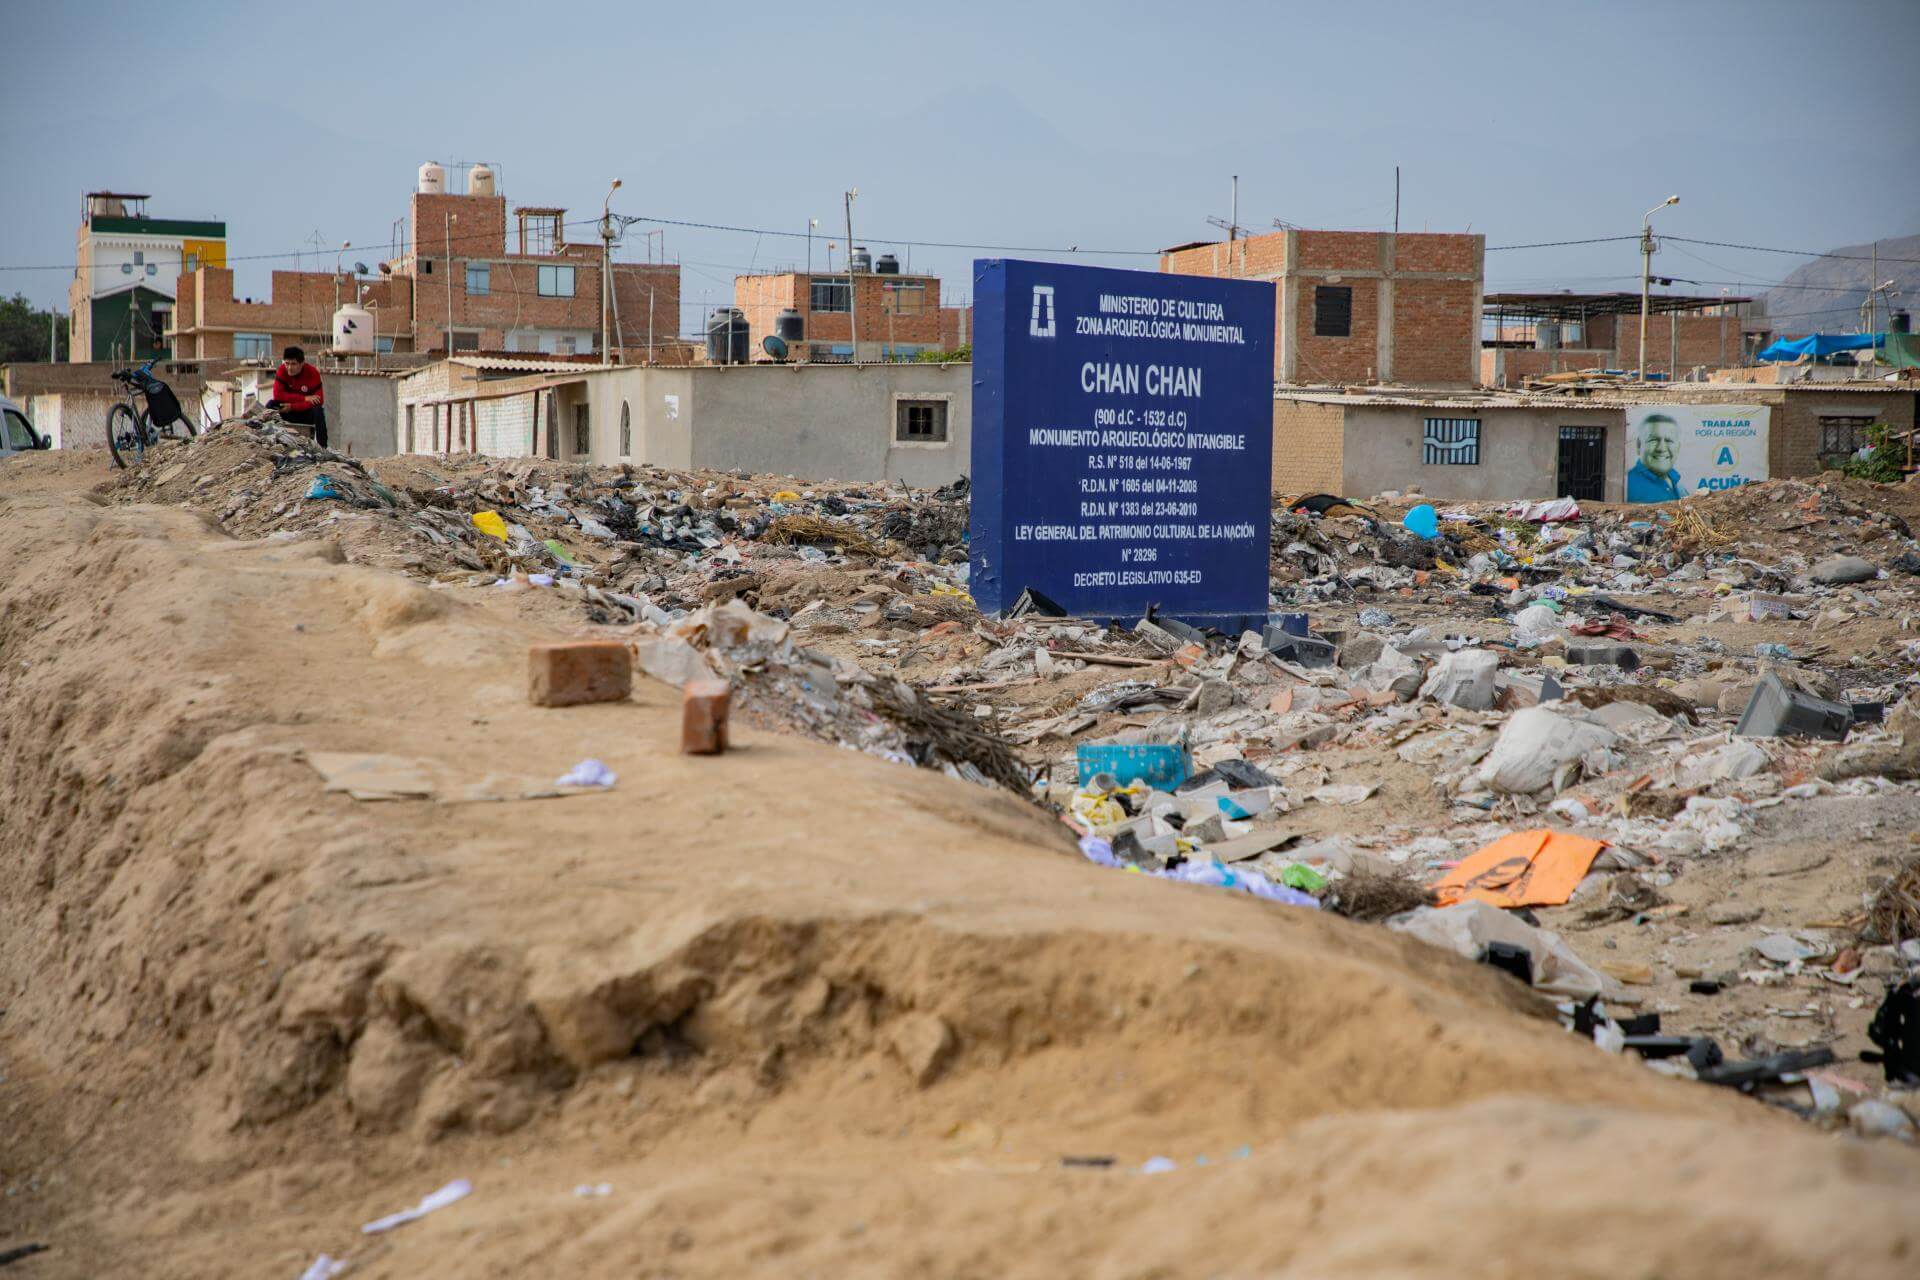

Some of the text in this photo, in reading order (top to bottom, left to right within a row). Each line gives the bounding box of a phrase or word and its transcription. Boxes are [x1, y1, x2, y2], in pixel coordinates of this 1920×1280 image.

[1099, 294, 1225, 321] MINISTERIO DE CULTURA
[1076, 316, 1245, 344] ZONA ARQUEOLÓGICA MONUMENTAL
[1081, 362, 1201, 398] CHAN CHAN
[1094, 408, 1115, 429] (900
[1117, 409, 1134, 425] d.C
[1143, 410, 1165, 426] 1532
[1167, 411, 1187, 431] d.C)
[1702, 420, 1751, 428] TRABAJAR
[1029, 428, 1245, 450] MONUMENTO ARQUEOLÓGICO INTANGIBLE
[1695, 428, 1757, 437] POR LA REGIÓN
[1088, 455, 1105, 469] R.S.
[1119, 455, 1134, 469] 518
[1135, 456, 1148, 471] del
[1149, 456, 1192, 471] 14-06-1967
[1716, 446, 1734, 465] A
[1081, 478, 1107, 493] R.D.N.
[1121, 479, 1140, 492] 1605
[1142, 479, 1155, 492] del
[1156, 479, 1198, 493] 04-11-2008
[1081, 501, 1107, 517] R.D.N.
[1121, 502, 1140, 516] 1383
[1141, 502, 1154, 516] del
[1155, 502, 1198, 516] 23-06-2010
[1015, 521, 1255, 541] LEY GENERAL DEL PATRIMONIO CULTURAL DE LA NACIÓN
[1133, 548, 1157, 562] 28296
[1073, 570, 1202, 587] DECRETO LEGISLATIVO 635-ED
